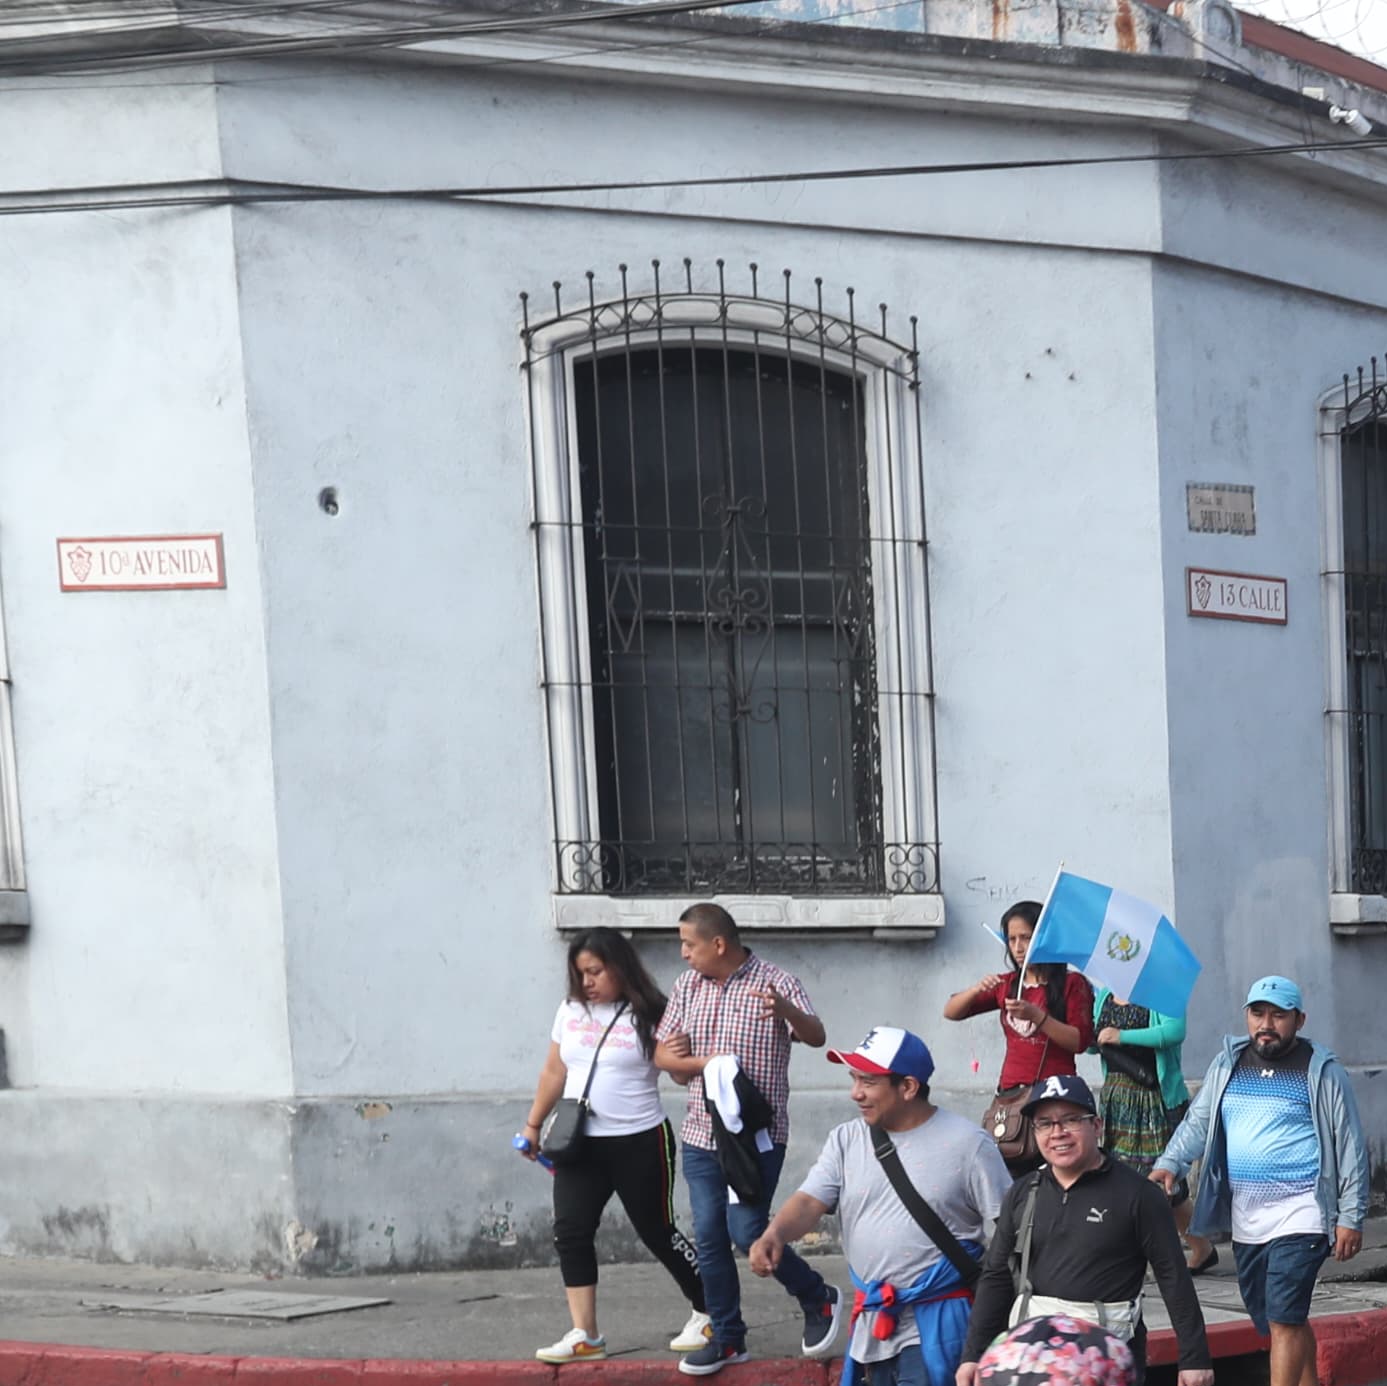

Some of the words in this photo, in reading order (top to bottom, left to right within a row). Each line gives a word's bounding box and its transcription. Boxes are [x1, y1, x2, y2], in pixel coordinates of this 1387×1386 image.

[134, 549, 213, 576] AVENIDA
[1220, 582, 1235, 606] 13
[1239, 584, 1281, 612] CALLE
